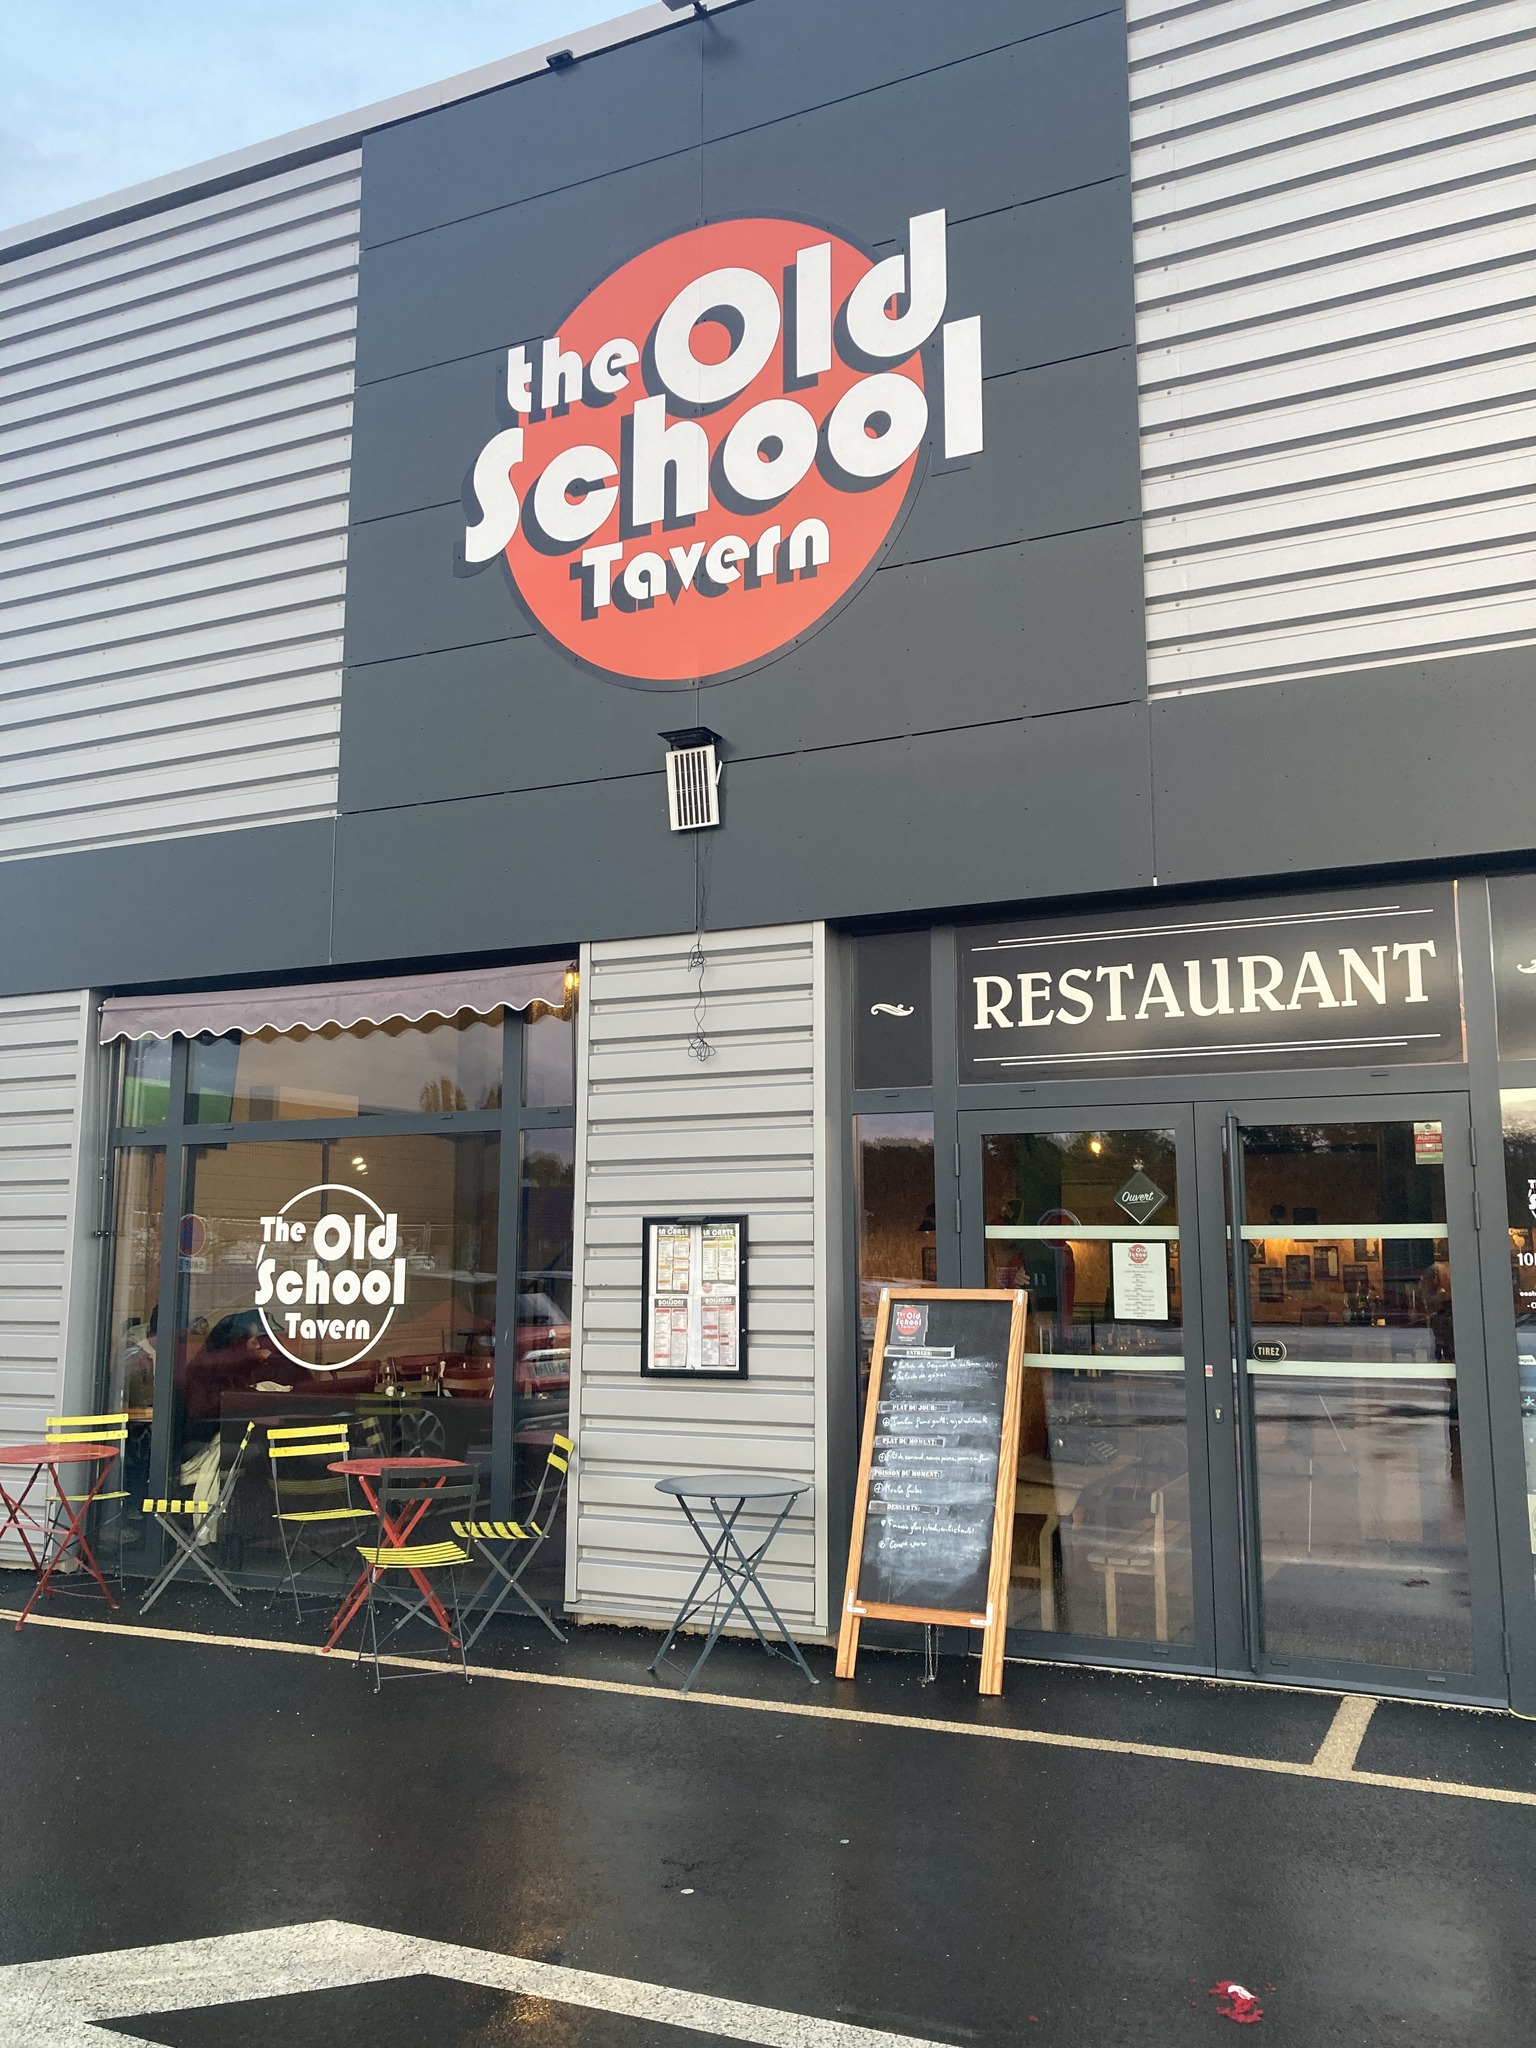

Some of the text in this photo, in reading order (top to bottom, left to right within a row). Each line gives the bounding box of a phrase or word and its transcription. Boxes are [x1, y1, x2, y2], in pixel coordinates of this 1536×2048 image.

[506, 208, 948, 412] the Old
[465, 315, 984, 563] School
[581, 517, 831, 608] Tavern
[972, 940, 1437, 1030] RESTAURANT
[1122, 1191, 1154, 1203] Ouvert
[260, 1213, 398, 1261] The Old
[1517, 1252, 1536, 1266] 10
[254, 1257, 407, 1306] School
[285, 1312, 371, 1340] Tavern
[895, 1318, 922, 1326] School
[906, 1312, 921, 1320] Old
[1257, 1346, 1280, 1357] TIREZ
[882, 1437, 898, 1445] PLAT
[874, 1470, 900, 1479] POISSON
